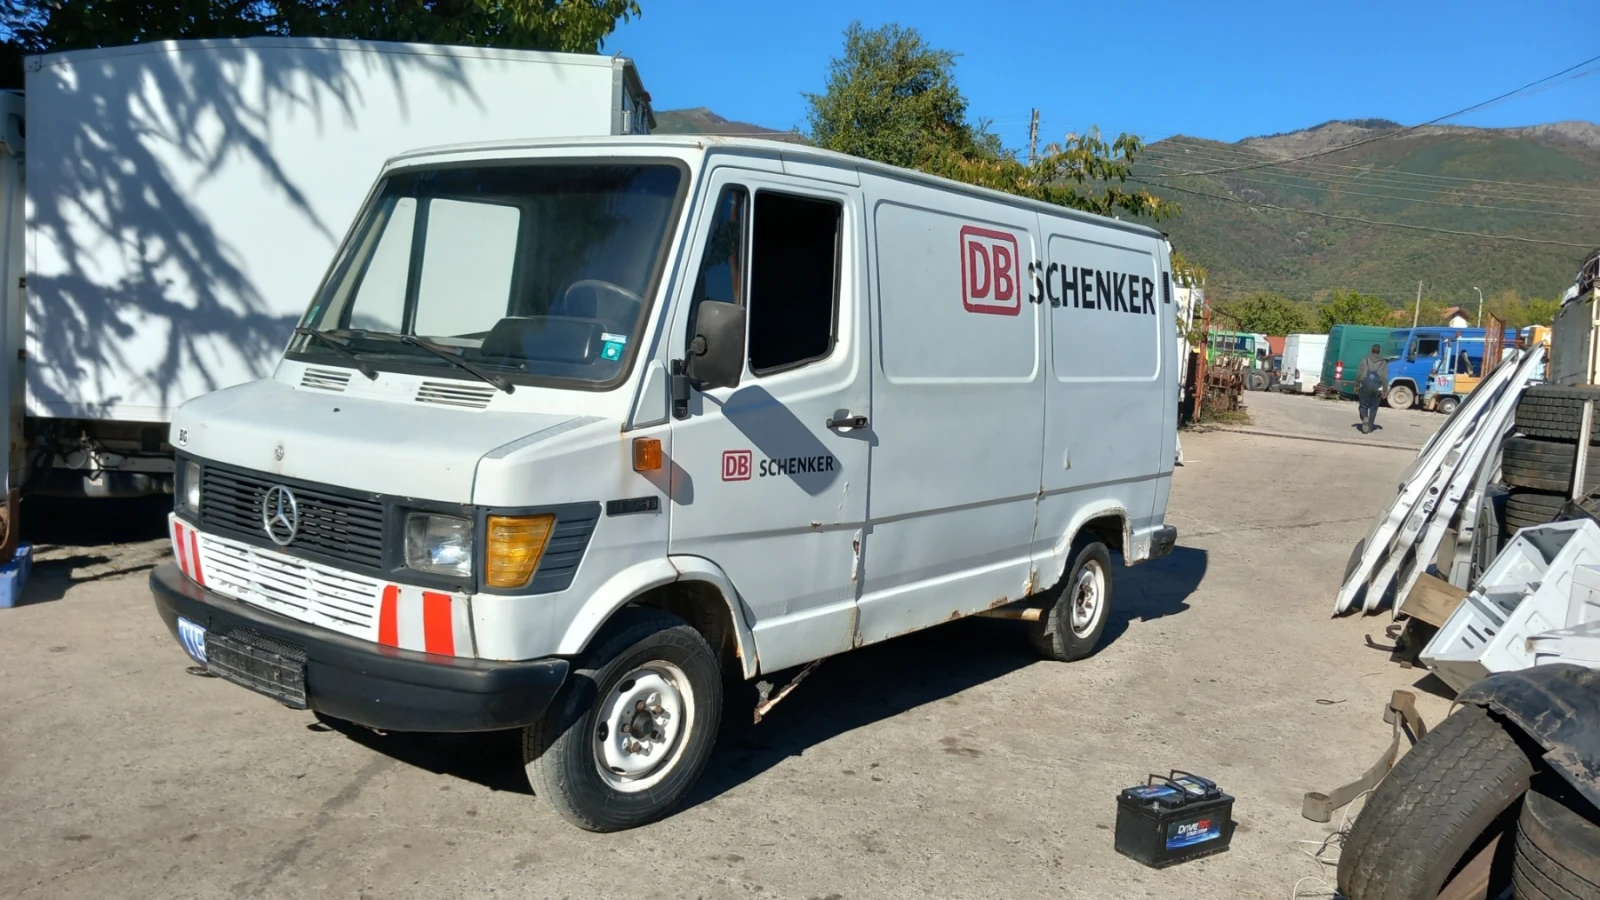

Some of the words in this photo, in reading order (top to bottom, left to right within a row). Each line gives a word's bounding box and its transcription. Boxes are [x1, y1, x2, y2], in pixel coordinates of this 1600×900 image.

[968, 240, 1014, 301] DB
[1028, 259, 1156, 315] SCHENKER
[179, 428, 188, 443] BG
[725, 455, 749, 477] DB
[759, 456, 834, 477] SCHENKER
